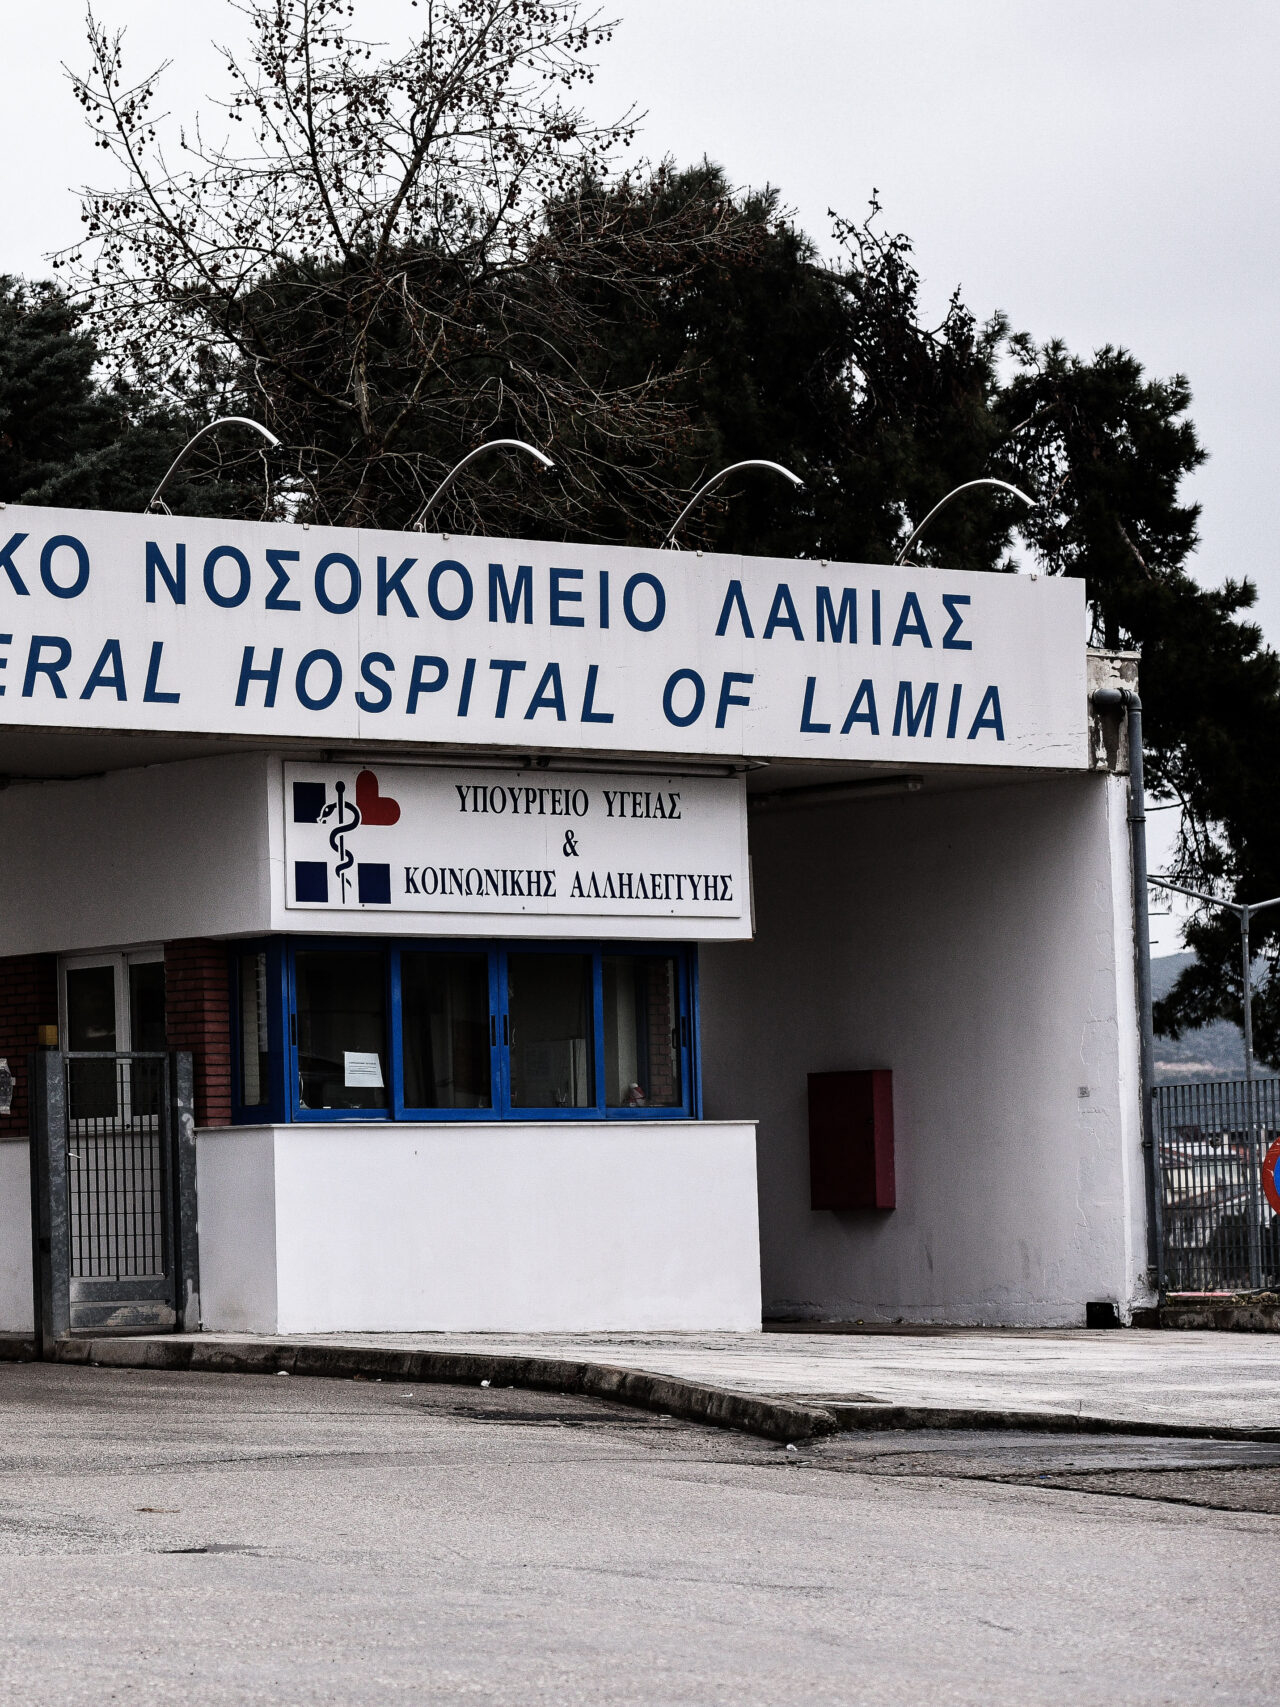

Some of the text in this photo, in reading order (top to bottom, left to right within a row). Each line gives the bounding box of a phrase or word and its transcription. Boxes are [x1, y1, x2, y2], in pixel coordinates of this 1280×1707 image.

[146, 541, 666, 633] ΝΟΣΟΚΟΜΕΙΟ
[715, 579, 973, 651] ΛΑΜΙΑΣ
[234, 645, 615, 724] HOSPITAL
[662, 668, 755, 729] OF
[799, 676, 1005, 742] LAMIA
[455, 785, 682, 820] ΥΠΟΥΡΓΕΙΟ ΥΓΕΙΑΣ
[562, 829, 580, 858] &
[404, 866, 733, 902] ΚΟΙΝΩΝΙΚΗΣ ΑΛΛΗΛΕΓΓΥΗΣ
